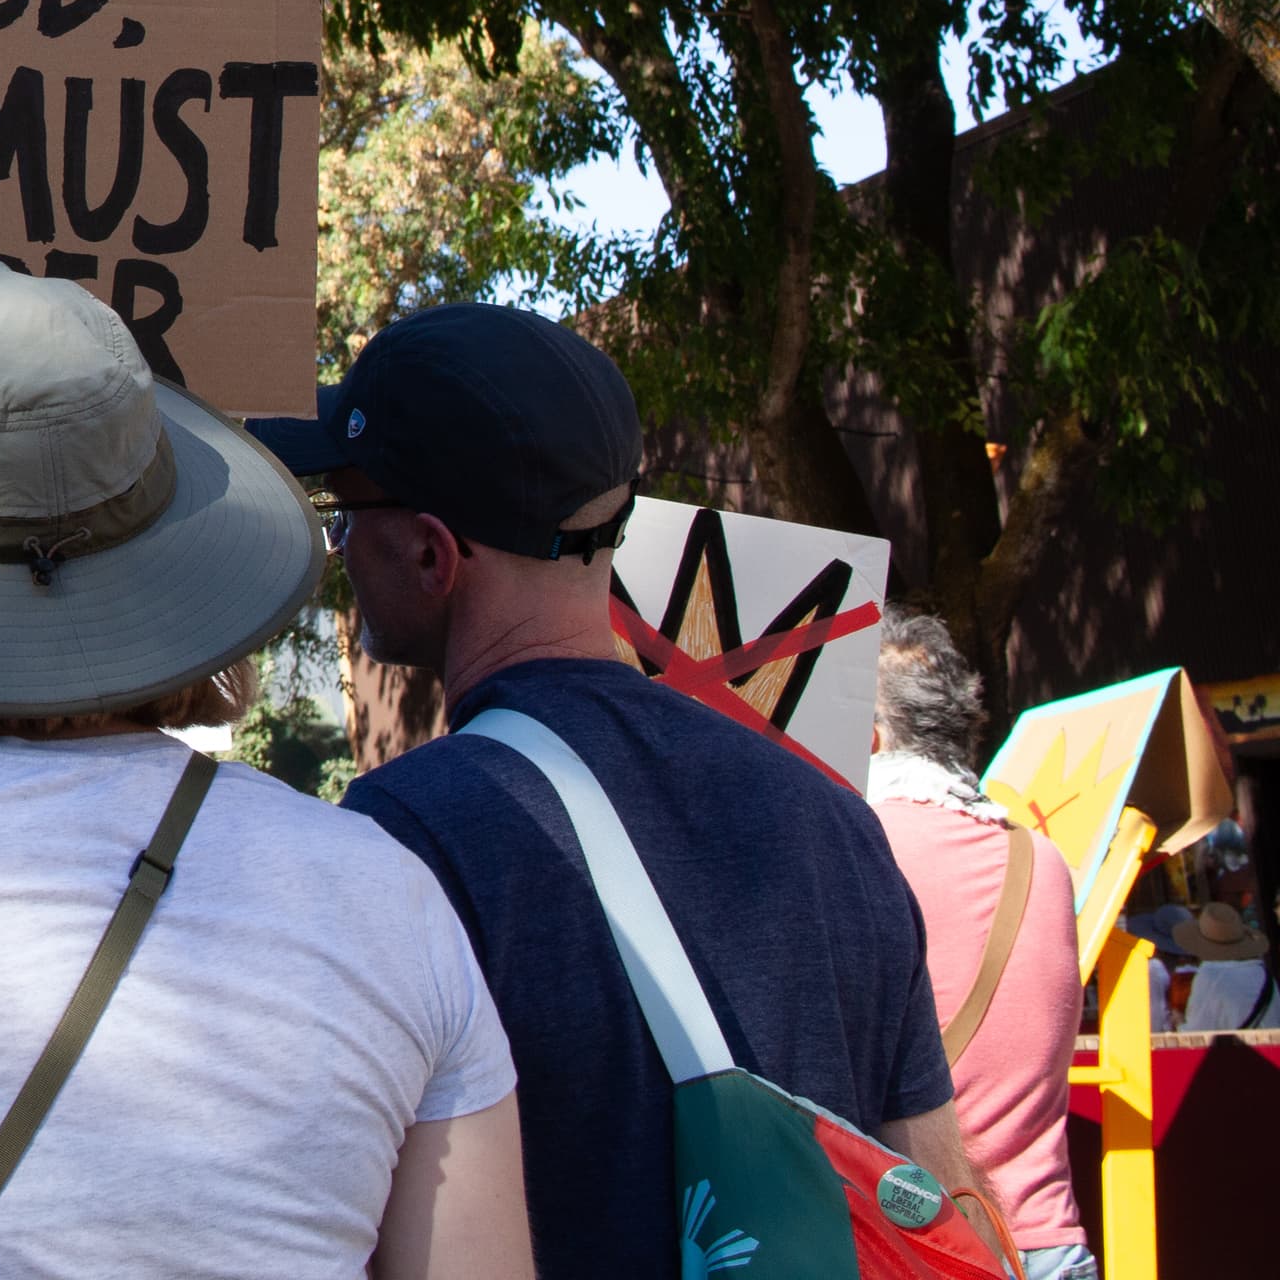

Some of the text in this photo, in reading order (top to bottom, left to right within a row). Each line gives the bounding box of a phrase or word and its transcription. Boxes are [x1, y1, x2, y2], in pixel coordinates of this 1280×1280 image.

[883, 1174, 942, 1203] SCIENCE
[892, 1185, 925, 1206] IS NOT A
[880, 1199, 927, 1224] CONSPIRACY
[891, 1194, 921, 1214] LIBERAL
